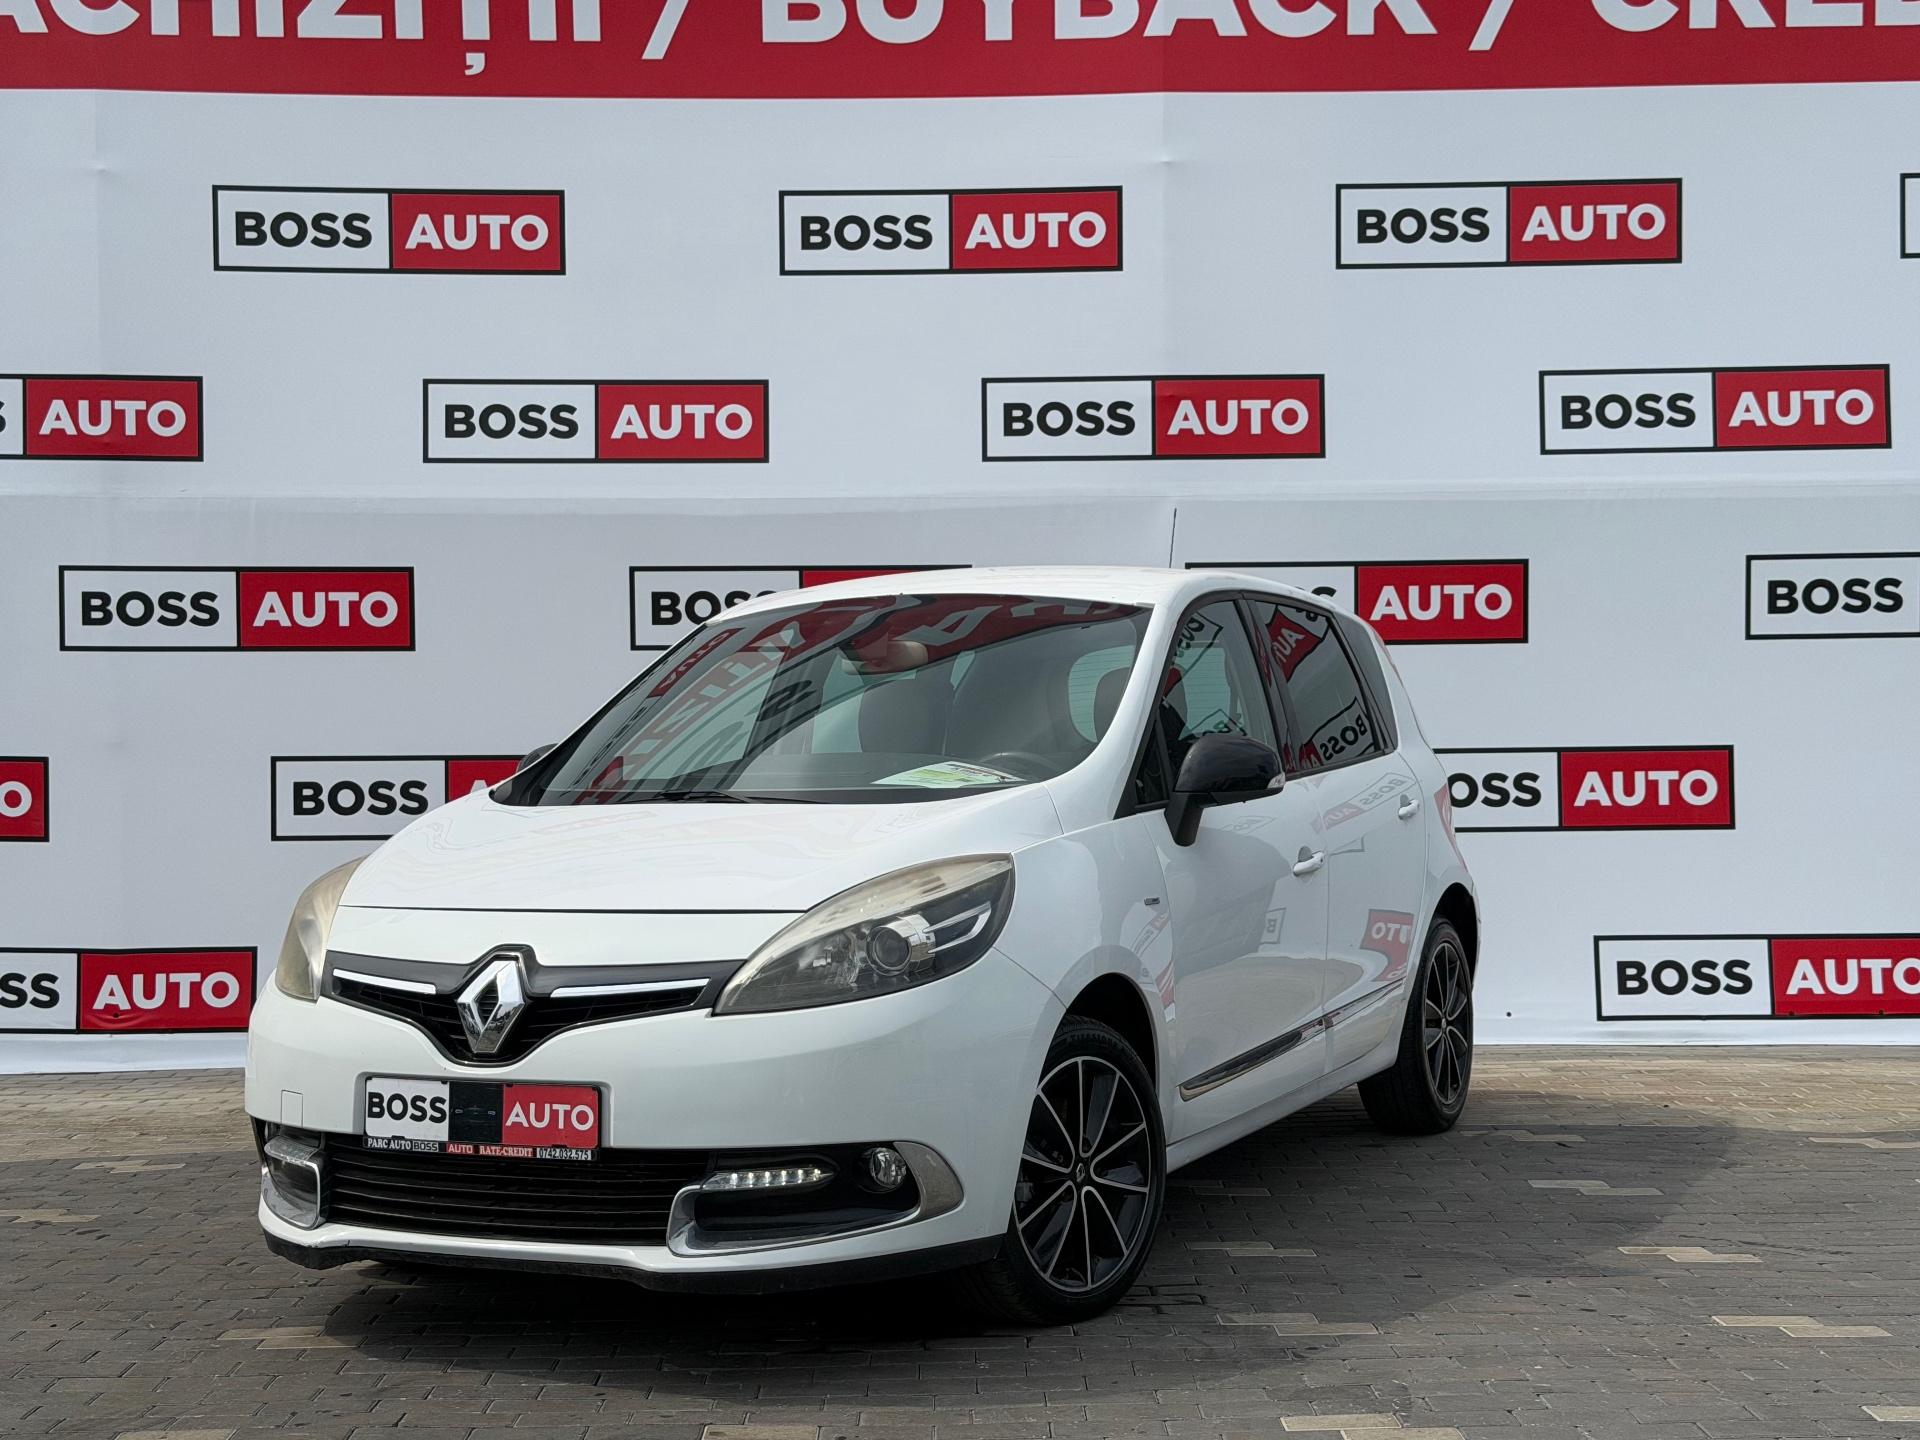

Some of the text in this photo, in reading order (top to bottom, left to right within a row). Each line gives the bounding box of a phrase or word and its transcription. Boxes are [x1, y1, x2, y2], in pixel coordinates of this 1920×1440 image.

[235, 211, 548, 251] BOSS AUTO
[801, 212, 1107, 250] BOSS AUTO
[1358, 204, 1666, 244] BOSS AUTO
[38, 399, 187, 436] AUTO
[445, 403, 753, 440] BOSS AUTO
[1004, 399, 1309, 437] BOSS AUTO
[1562, 389, 1874, 429] BOSS AUTO
[81, 590, 398, 627] BOSS AUTO
[1369, 583, 1513, 620] AUTO
[1768, 577, 1904, 614] BOSS
[292, 780, 429, 817] BOSS
[1447, 769, 1718, 809] OSS AUTO
[92, 971, 240, 1011] AUTO
[1616, 957, 1920, 996] BOSS AUTO
[367, 1091, 595, 1131] BOSS AUTO
[367, 1138, 388, 1149] PARC
[389, 1139, 412, 1151] AUTO
[413, 1141, 438, 1152] BOSS
[448, 1143, 473, 1154] AUTO
[479, 1145, 533, 1157] RATE-CREDIT
